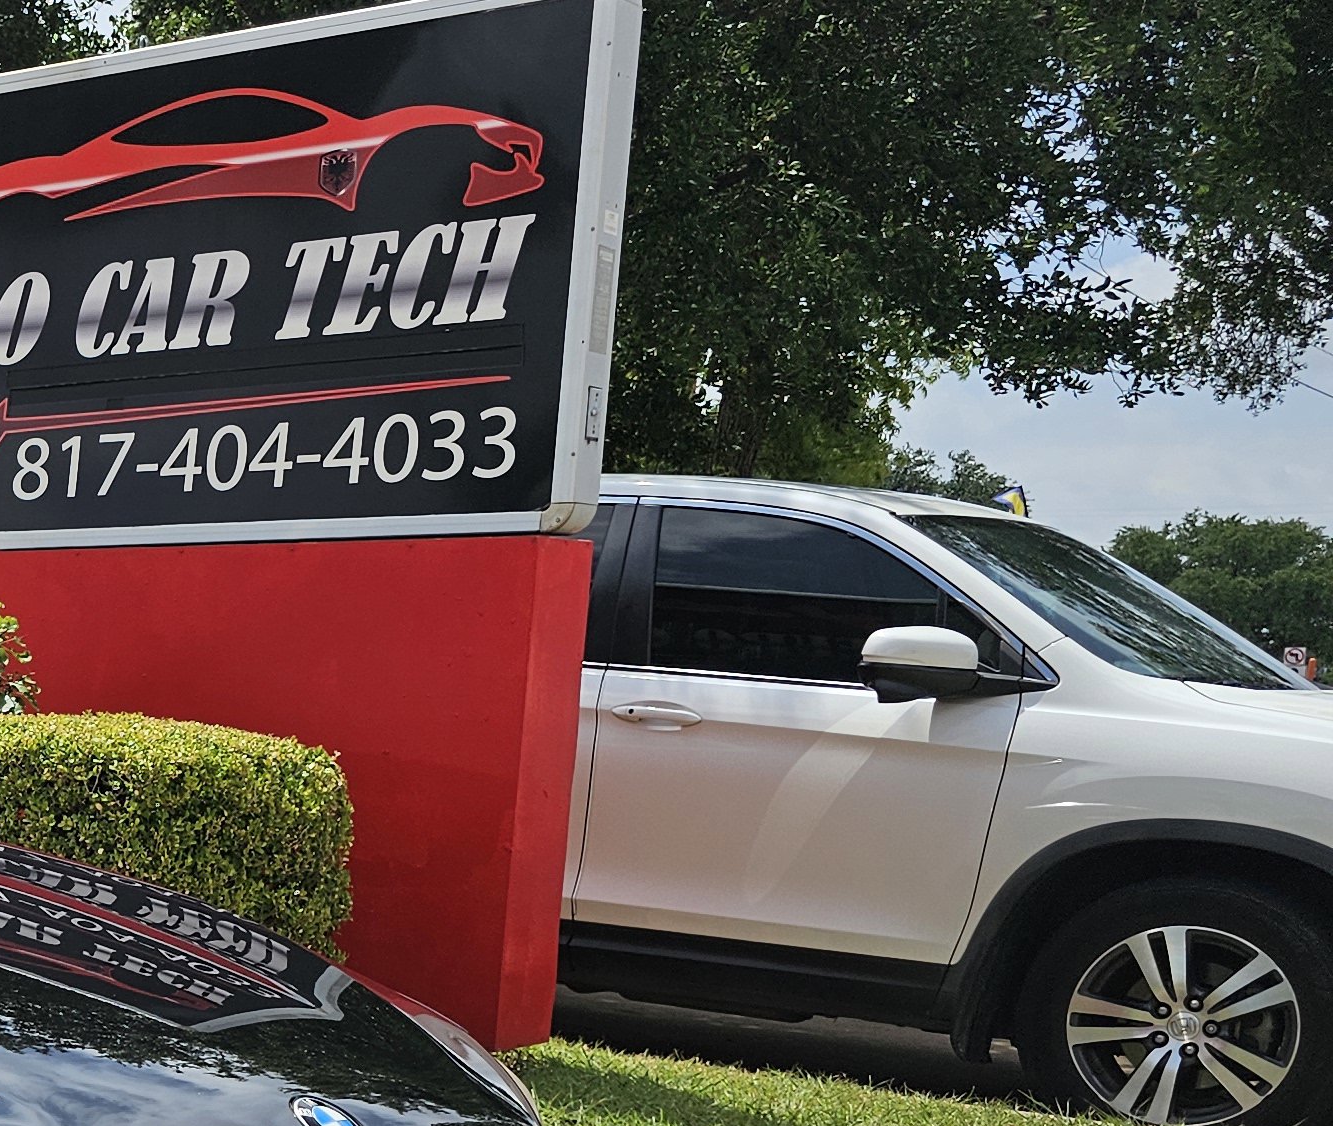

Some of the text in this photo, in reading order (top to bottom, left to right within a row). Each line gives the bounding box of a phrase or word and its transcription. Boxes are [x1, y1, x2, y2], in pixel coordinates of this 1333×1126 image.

[75, 250, 252, 359] CAR
[274, 213, 537, 343] TECH
[11, 406, 517, 501] 817-404-4033
